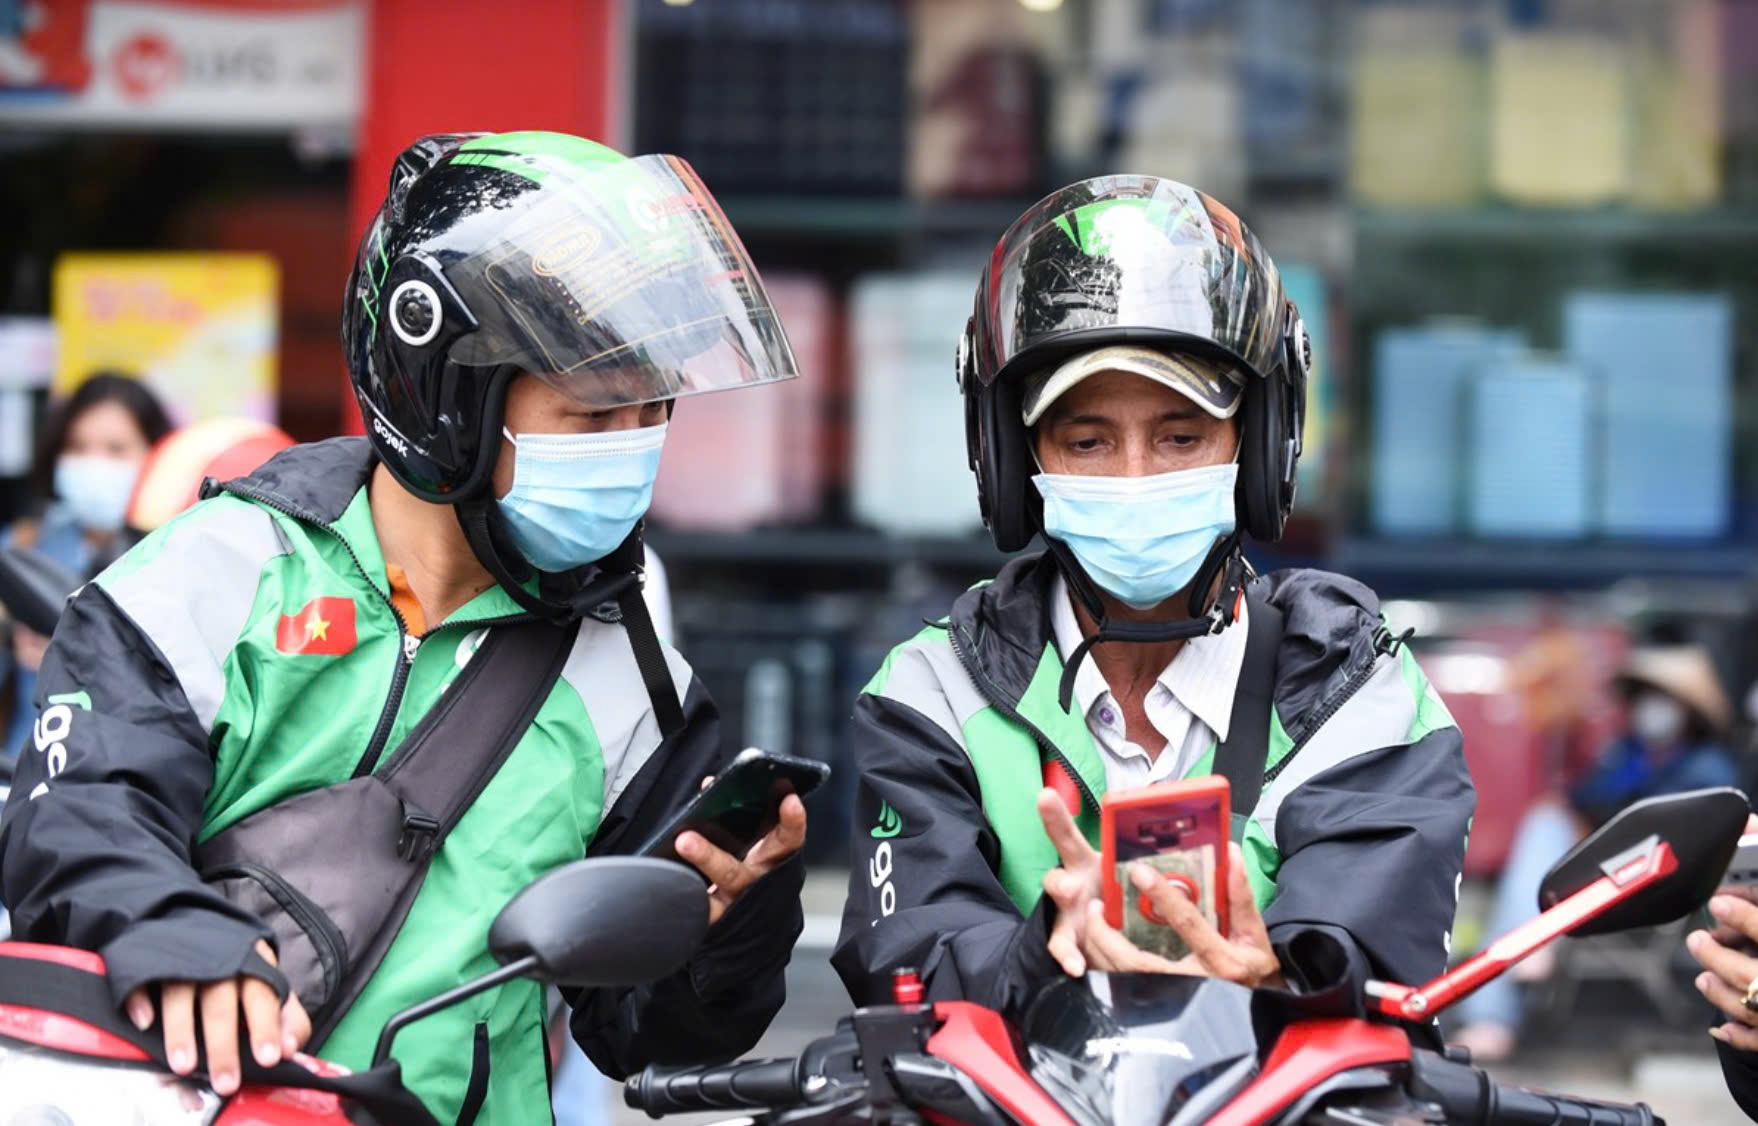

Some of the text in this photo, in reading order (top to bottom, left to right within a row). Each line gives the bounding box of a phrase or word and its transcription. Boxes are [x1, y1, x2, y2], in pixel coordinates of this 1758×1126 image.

[373, 417, 409, 458] gojek
[30, 704, 73, 800] go
[869, 841, 896, 927] go
